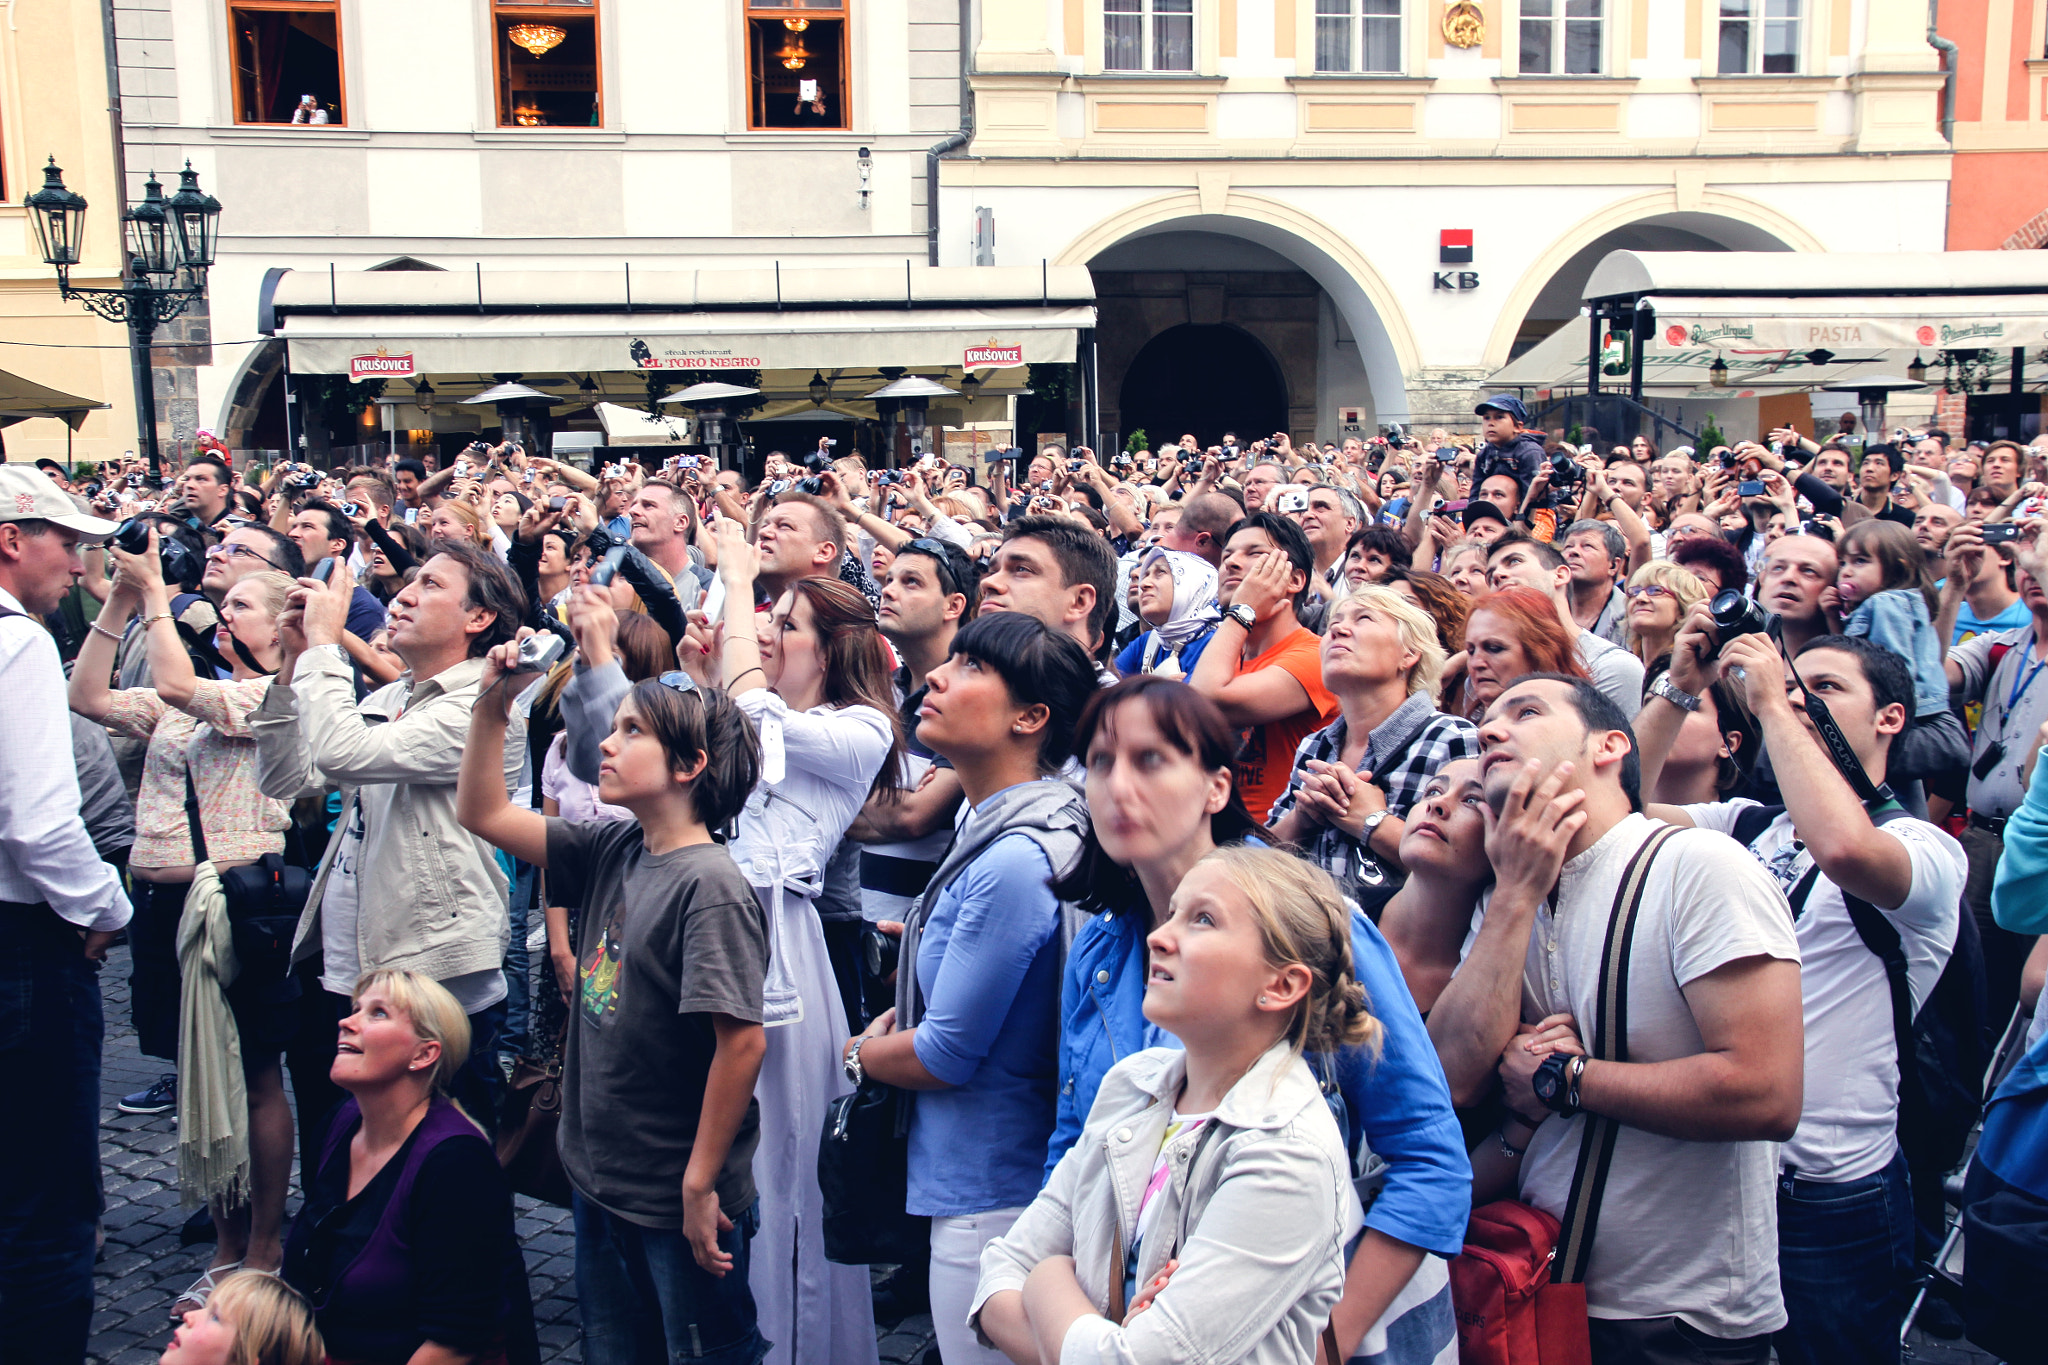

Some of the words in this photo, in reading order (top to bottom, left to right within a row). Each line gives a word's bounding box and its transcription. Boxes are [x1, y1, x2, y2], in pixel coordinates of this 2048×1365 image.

[1433, 271, 1480, 290] KB
[1690, 324, 1722, 346] Pilsner
[1721, 323, 1753, 340] Urquell
[1808, 326, 1862, 343] PASTA
[688, 348, 732, 356] restaurant
[966, 348, 1019, 362] KRUŠOVICE
[353, 357, 411, 372] KRUŠOVICE
[643, 358, 662, 368] EL
[710, 357, 760, 368] NEGRO
[1344, 424, 1360, 432] KB
[1824, 724, 1857, 771] COOLPIX
[1239, 765, 1264, 787] IVE
